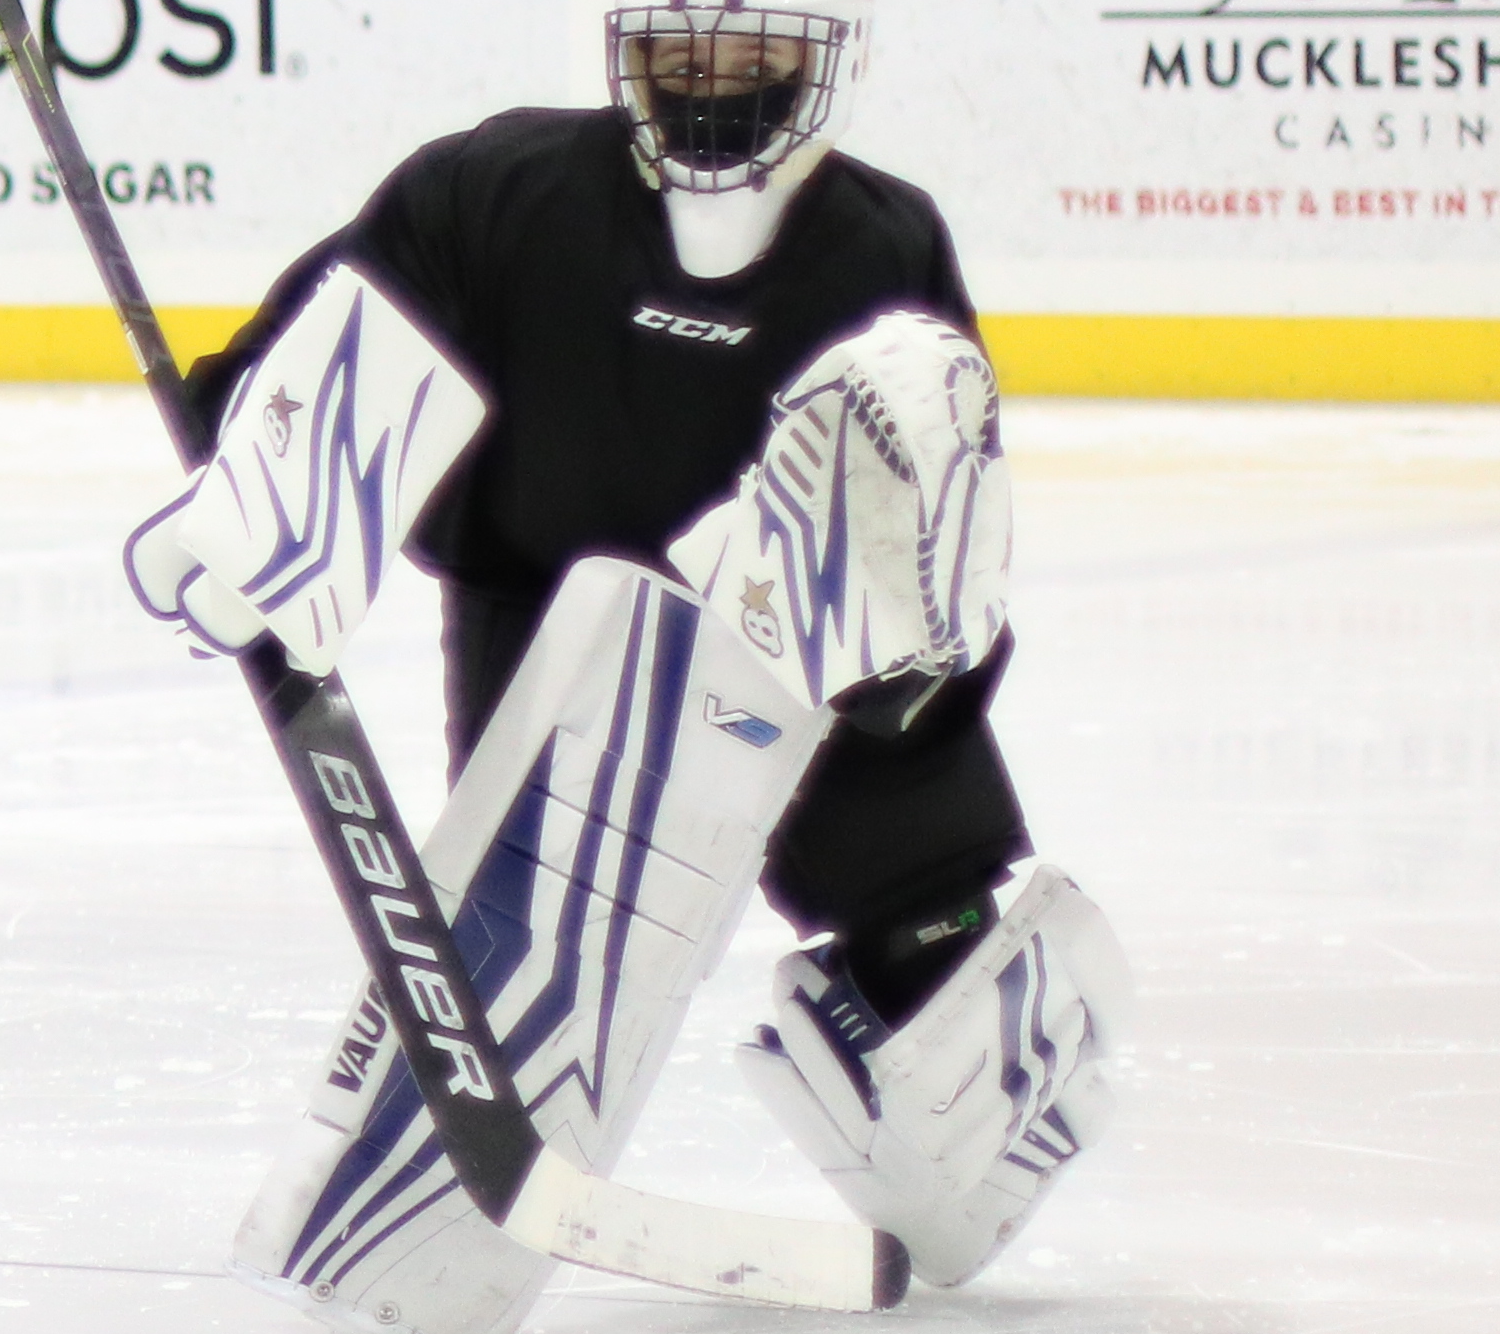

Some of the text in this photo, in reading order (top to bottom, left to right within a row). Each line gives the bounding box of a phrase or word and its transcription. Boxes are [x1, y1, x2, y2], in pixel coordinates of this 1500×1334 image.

[30, 163, 216, 205] SGAR
[1060, 190, 1121, 216] THE
[1136, 190, 1285, 216] BIGGEST
[1333, 190, 1418, 216] BEST
[1434, 188, 1467, 216] IN
[632, 306, 753, 347] CCM
[308, 749, 495, 1101] BAUER
